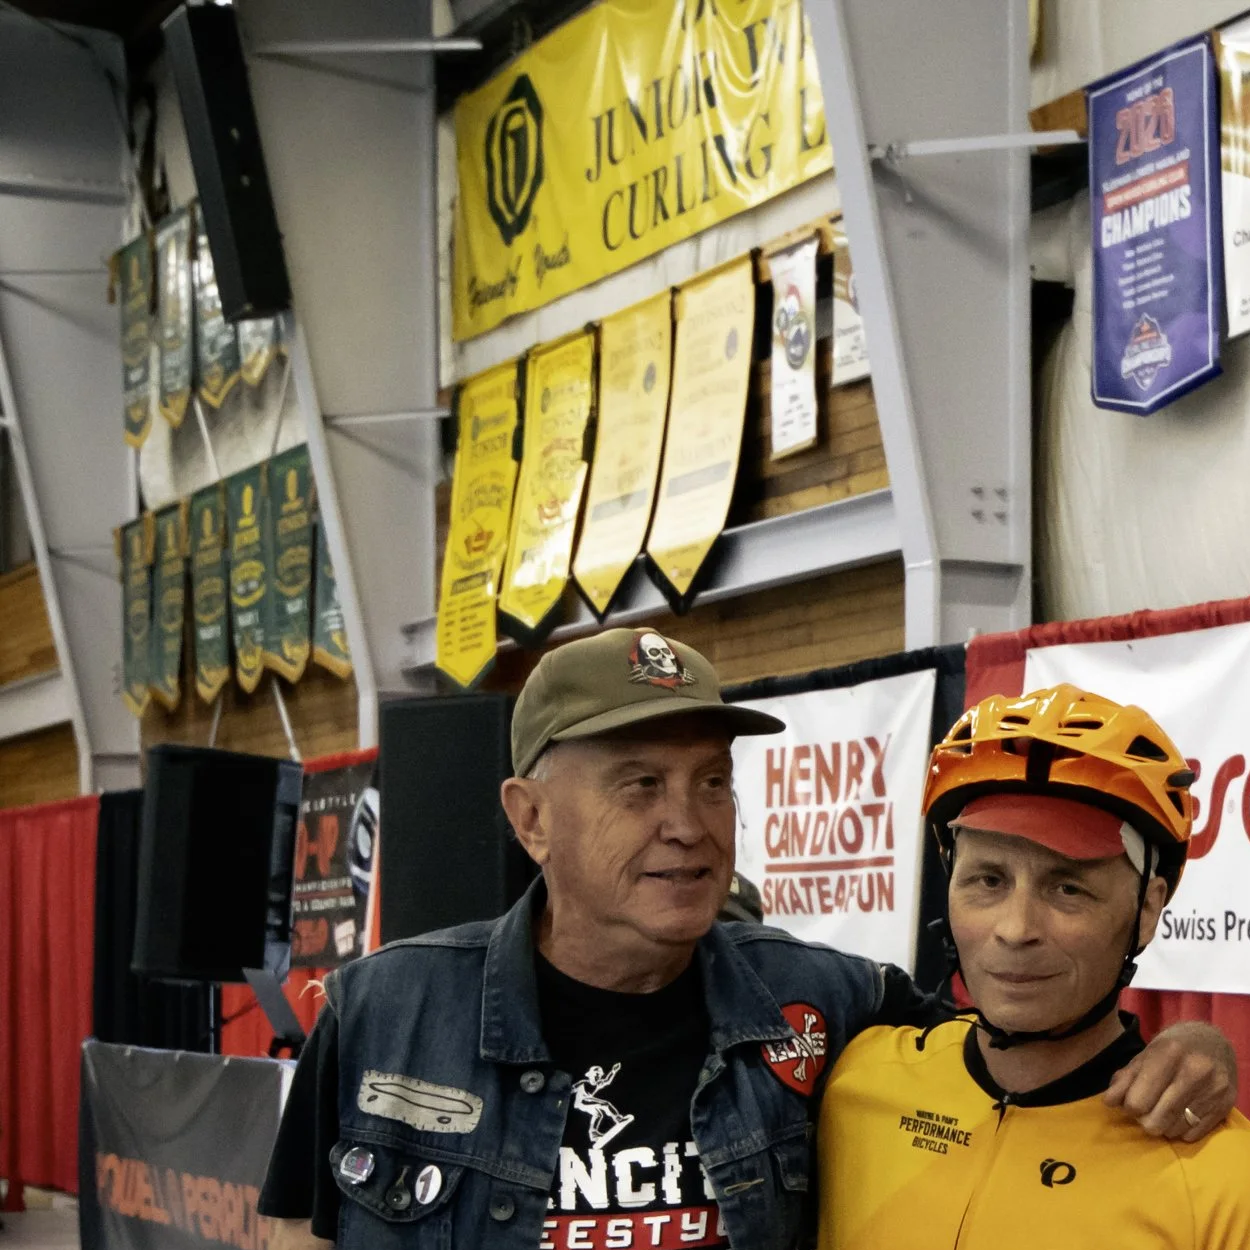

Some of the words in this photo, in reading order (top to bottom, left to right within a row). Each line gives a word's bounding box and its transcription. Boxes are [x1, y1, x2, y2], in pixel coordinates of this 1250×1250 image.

[585, 50, 717, 183] JUNIOR
[602, 111, 773, 252] CURLING
[1101, 183, 1192, 248] CHAMPIONS
[766, 732, 893, 809] HENRY
[765, 801, 894, 859] CANDIOTI
[762, 871, 894, 917] SKATE4FUN
[1161, 909, 1217, 942] Swiss
[899, 1115, 973, 1147] PERFORMANCE
[912, 1135, 949, 1155] BICYCLES
